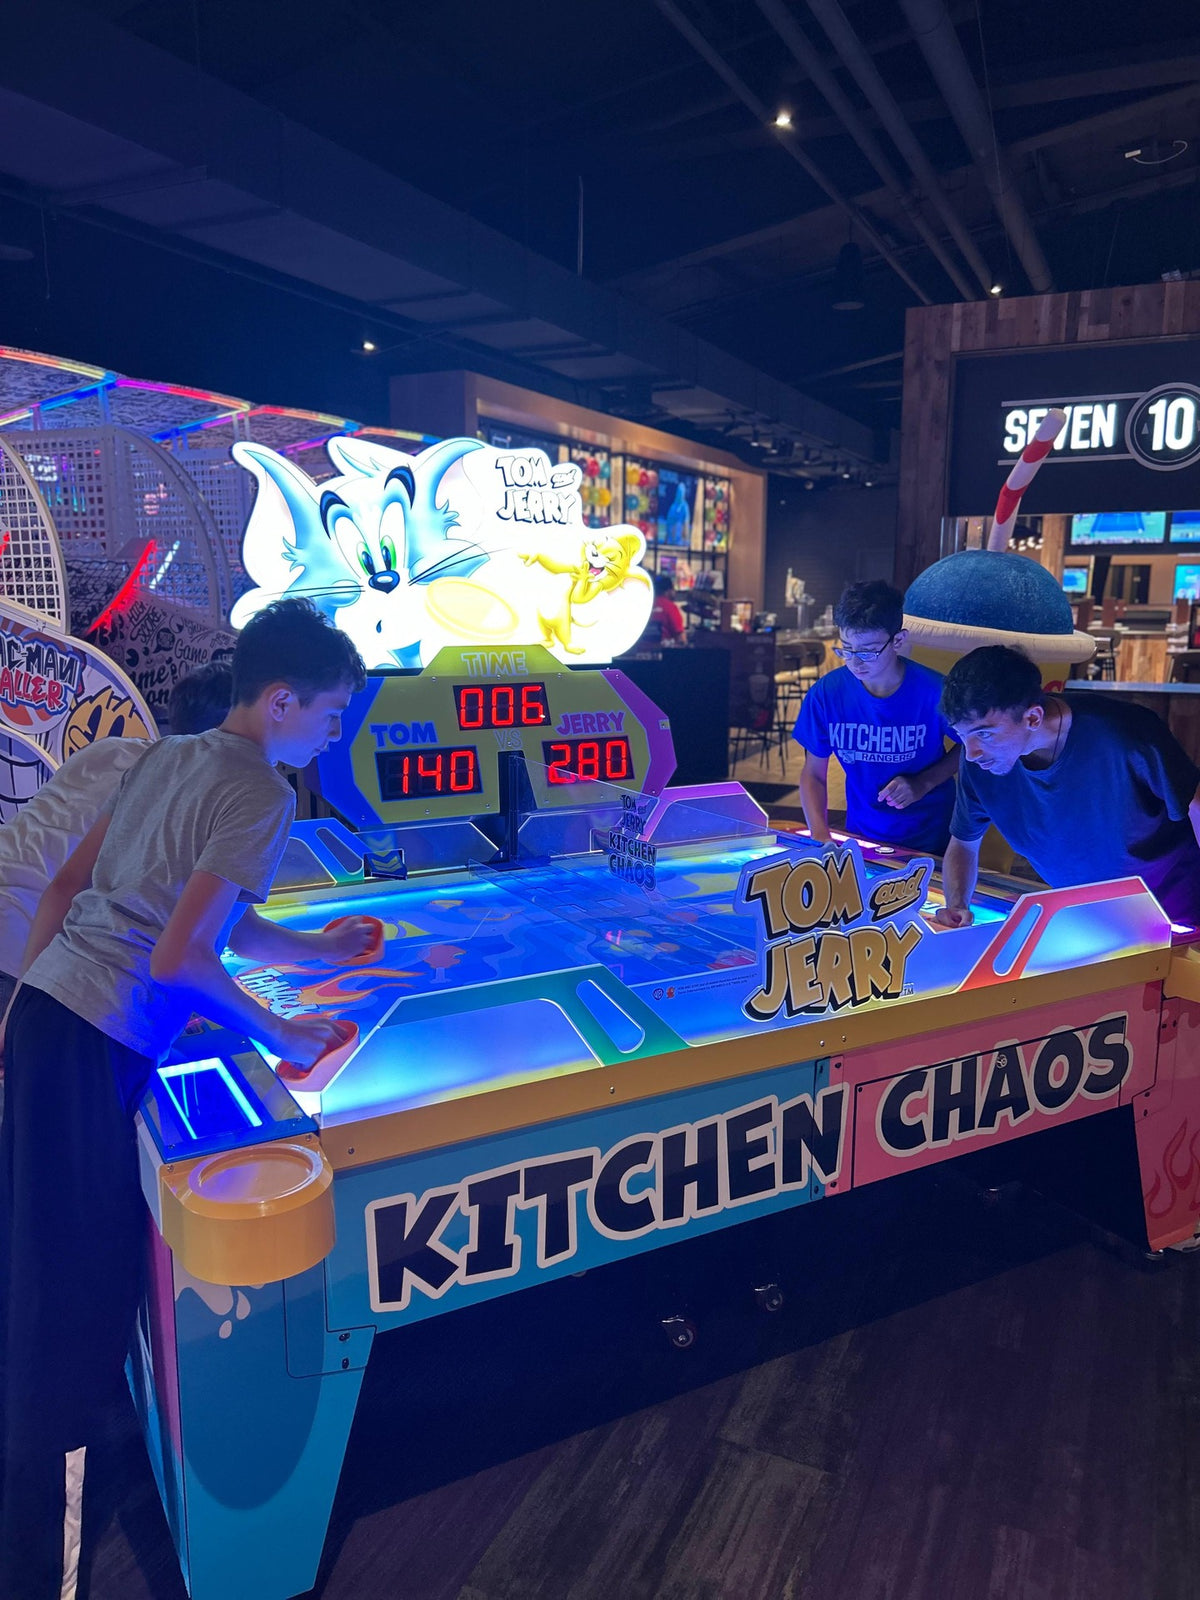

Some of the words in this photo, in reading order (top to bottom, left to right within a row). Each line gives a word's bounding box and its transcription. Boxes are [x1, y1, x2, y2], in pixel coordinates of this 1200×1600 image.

[1148, 397, 1196, 451] 10
[495, 455, 549, 488] TOM
[496, 488, 577, 525] JERRY
[0, 635, 78, 689] C-MAN
[461, 651, 529, 678] TIME
[0, 666, 65, 710] ALLER
[460, 686, 544, 729] 006
[556, 711, 625, 736] JERRY
[370, 722, 438, 749] TOM
[493, 729, 523, 751] VS
[828, 722, 927, 753] KITCHENER
[402, 750, 475, 794] 140
[548, 740, 628, 784] 280
[860, 751, 914, 763] RANGERS
[621, 794, 637, 812] TOM
[621, 812, 646, 836] JERRY
[609, 830, 657, 864] KITCHEN
[609, 854, 656, 890] CHAOS
[746, 852, 864, 940] TOM
[869, 867, 927, 922] and
[745, 923, 923, 1020] JERRY
[367, 1085, 849, 1310] KITCHEN
[878, 1013, 1131, 1154] CHAOS
